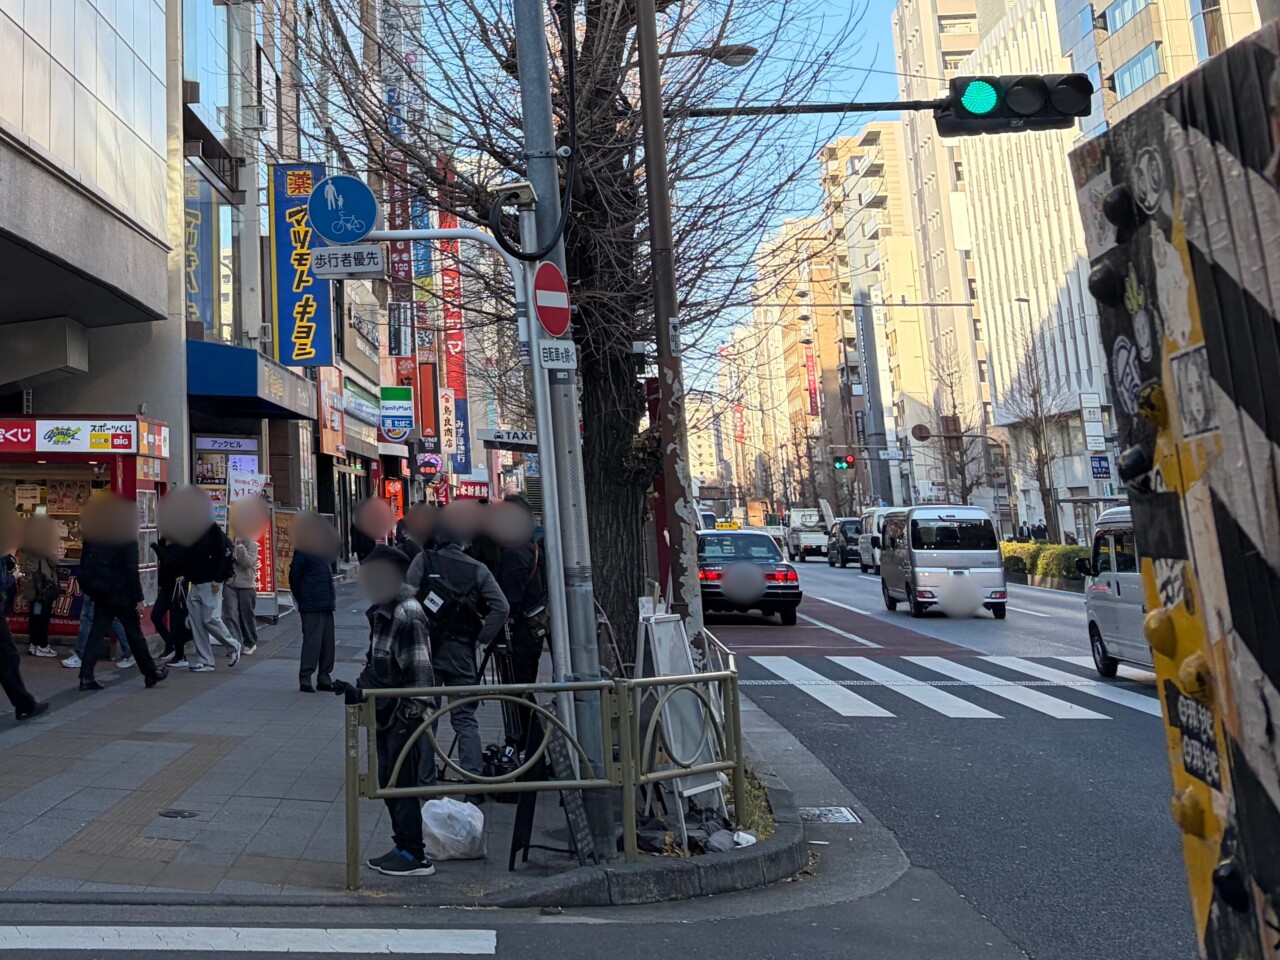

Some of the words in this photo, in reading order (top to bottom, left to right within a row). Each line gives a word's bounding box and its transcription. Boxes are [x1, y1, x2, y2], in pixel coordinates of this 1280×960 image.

[287, 171, 313, 196] 薬
[314, 251, 379, 269] 歩行者優先
[541, 346, 576, 364] 自転車を除く
[381, 404, 412, 413] FamilyMart
[90, 422, 133, 433] スポーツくじ
[384, 419, 393, 428] 酒
[443, 405, 454, 448] 鳥良商店
[455, 420, 466, 463] みずほ銀行
[505, 431, 533, 440] TAXI
